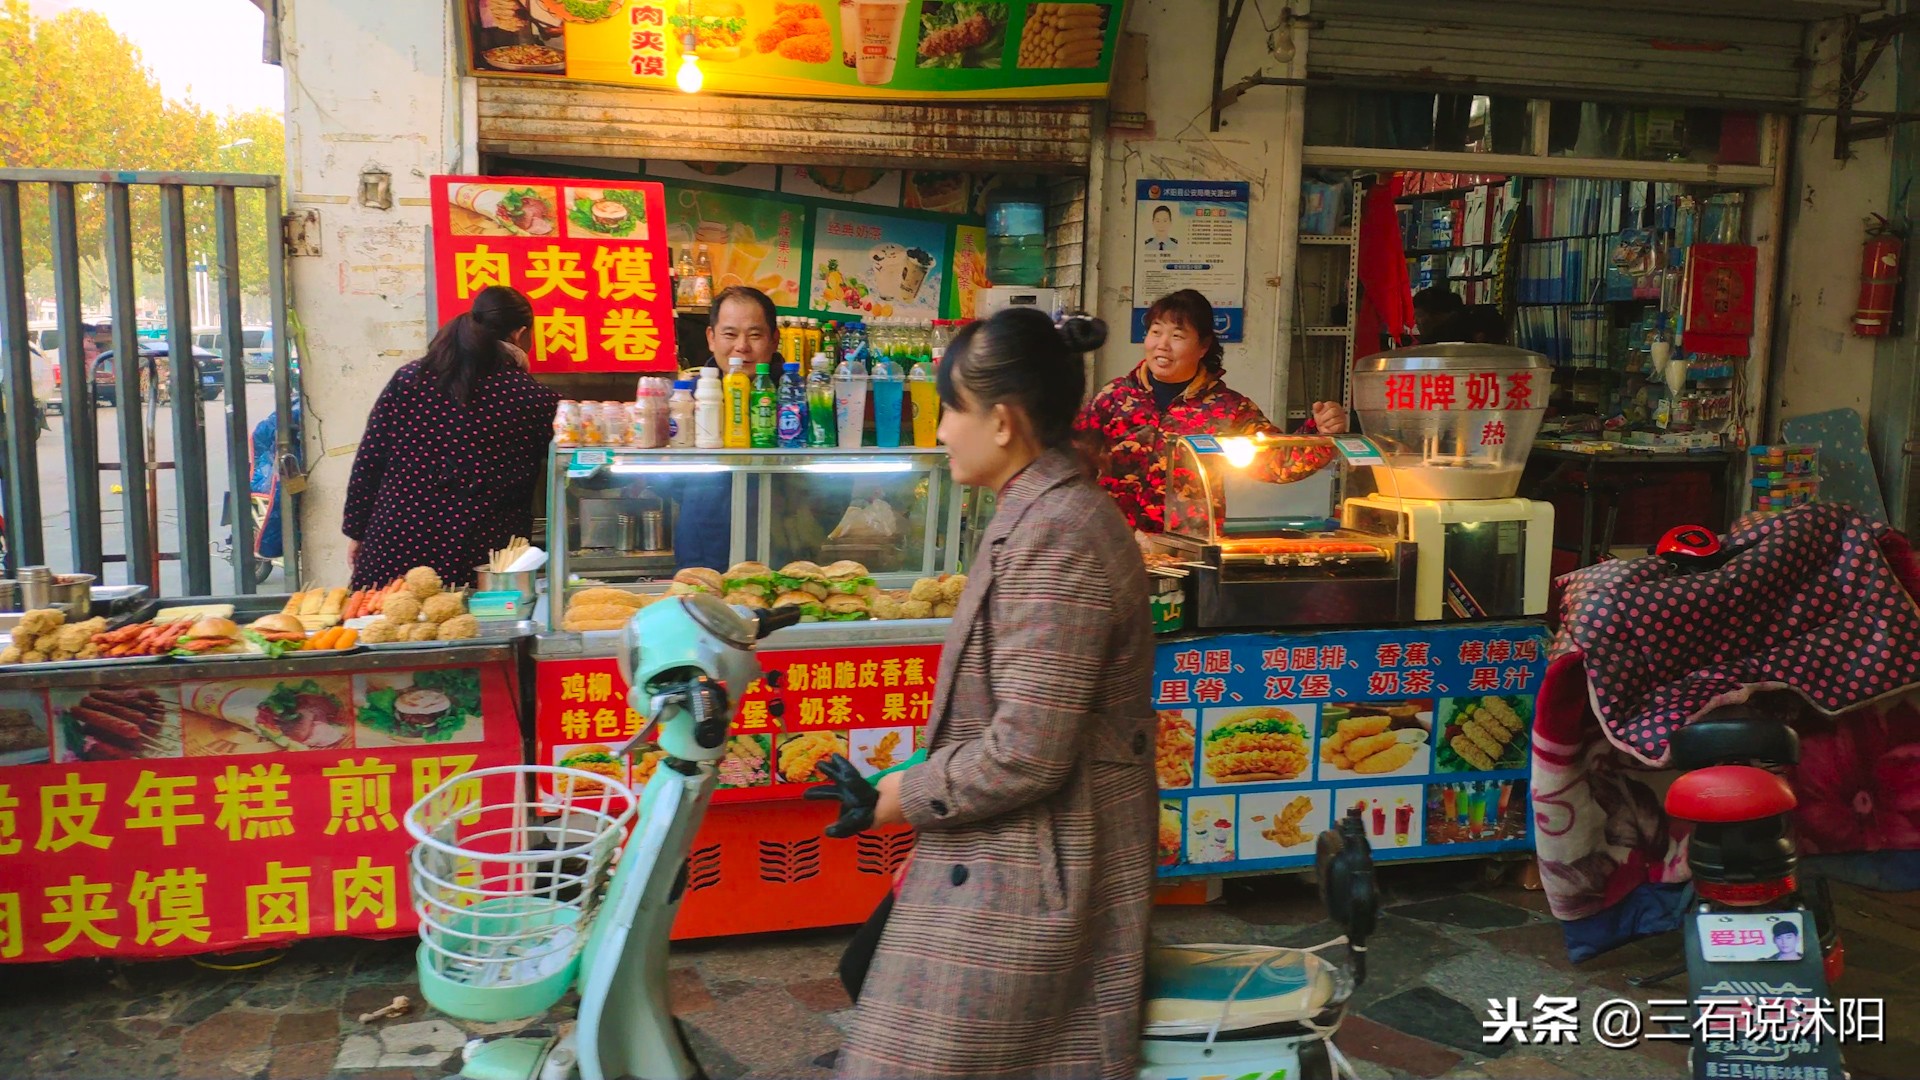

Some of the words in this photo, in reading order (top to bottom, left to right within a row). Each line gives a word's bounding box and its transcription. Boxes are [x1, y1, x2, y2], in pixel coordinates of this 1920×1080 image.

[630, 5, 665, 77] 肉夹馍
[826, 222, 882, 240] 经典奶茶
[455, 244, 658, 302] 肉夹馍
[1385, 371, 1534, 411] 招牌奶茶
[1480, 421, 1507, 446] 热
[746, 657, 936, 694] 、奶油脆皮香蕉、
[729, 691, 934, 729] 堡、奶茶、果汁
[1710, 929, 1766, 946] 爱玛
